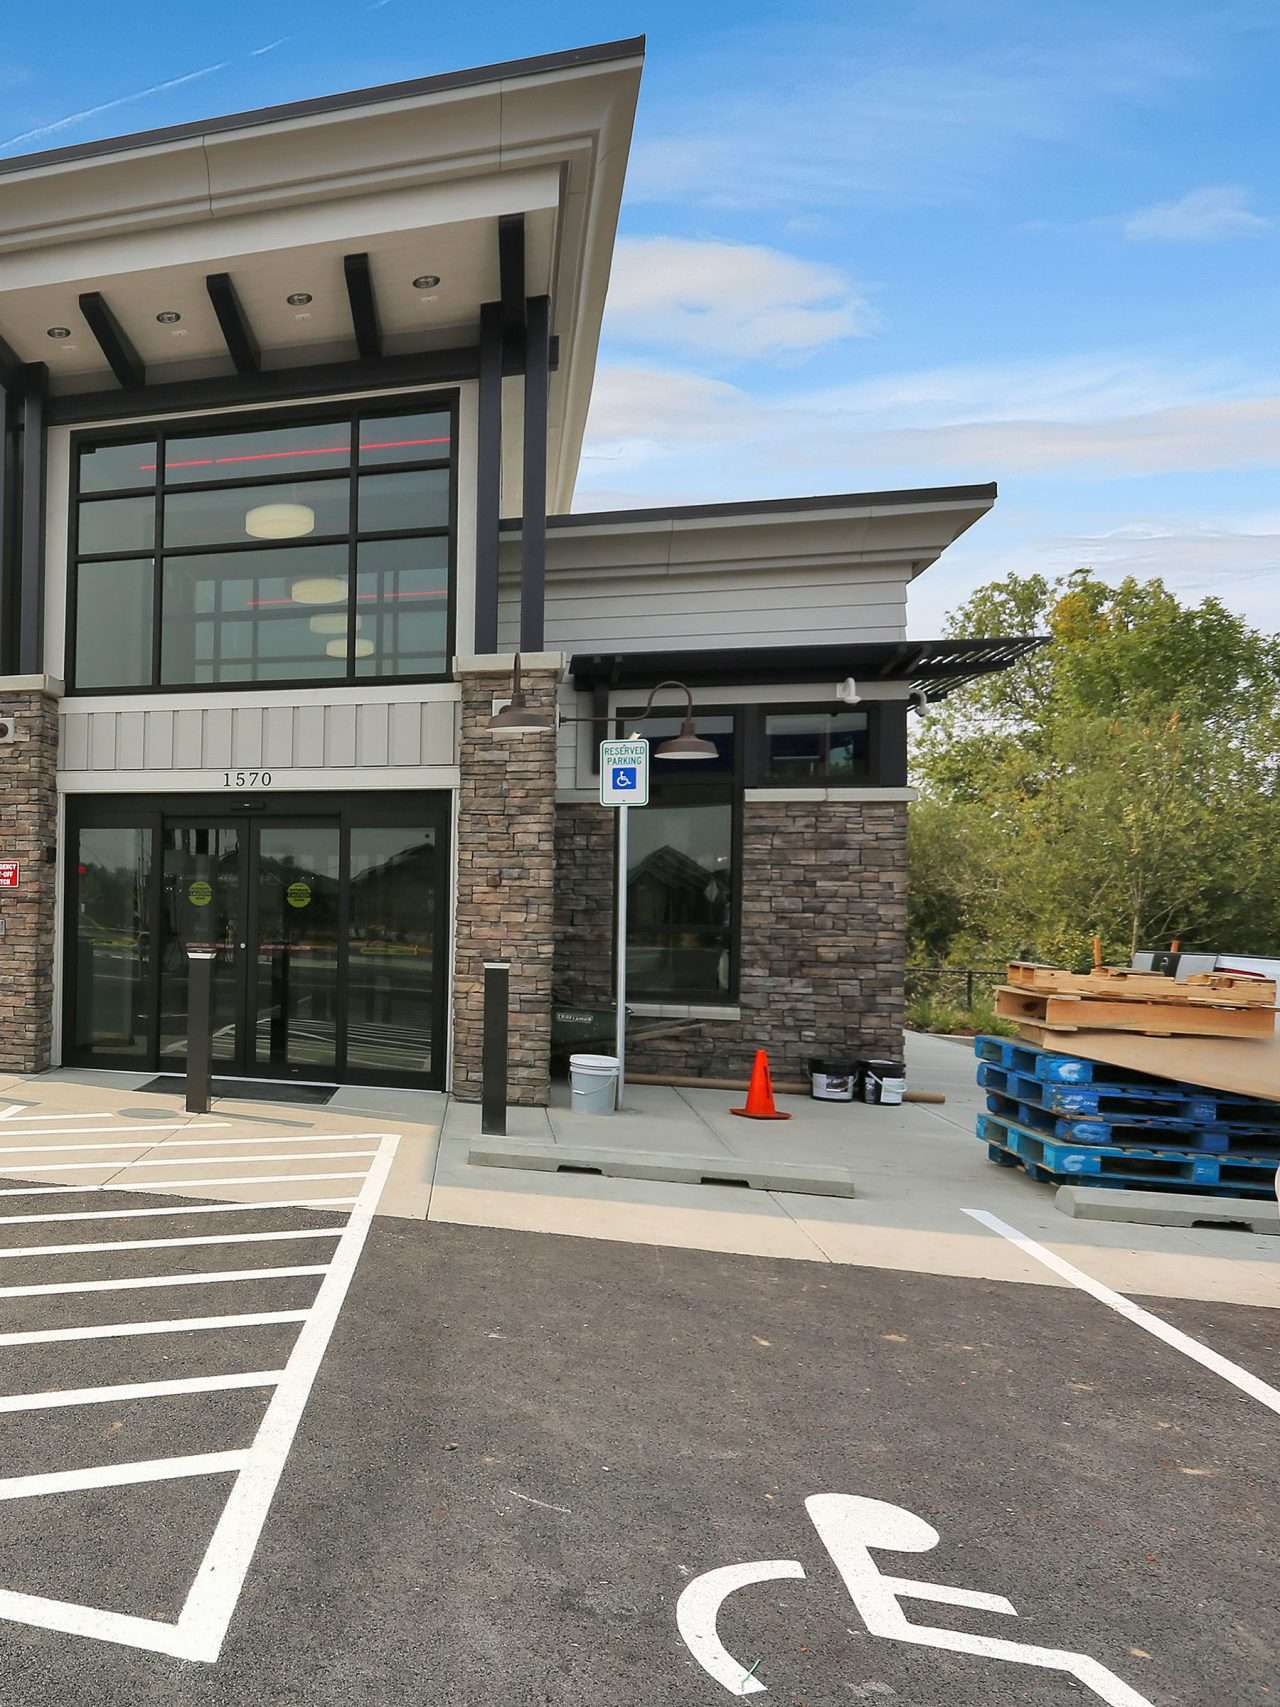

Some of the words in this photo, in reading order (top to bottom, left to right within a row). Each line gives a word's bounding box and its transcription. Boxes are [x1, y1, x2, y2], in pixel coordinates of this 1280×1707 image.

[604, 746, 645, 756] RESERVED
[607, 756, 642, 765] PARKING
[223, 772, 272, 787] 1570
